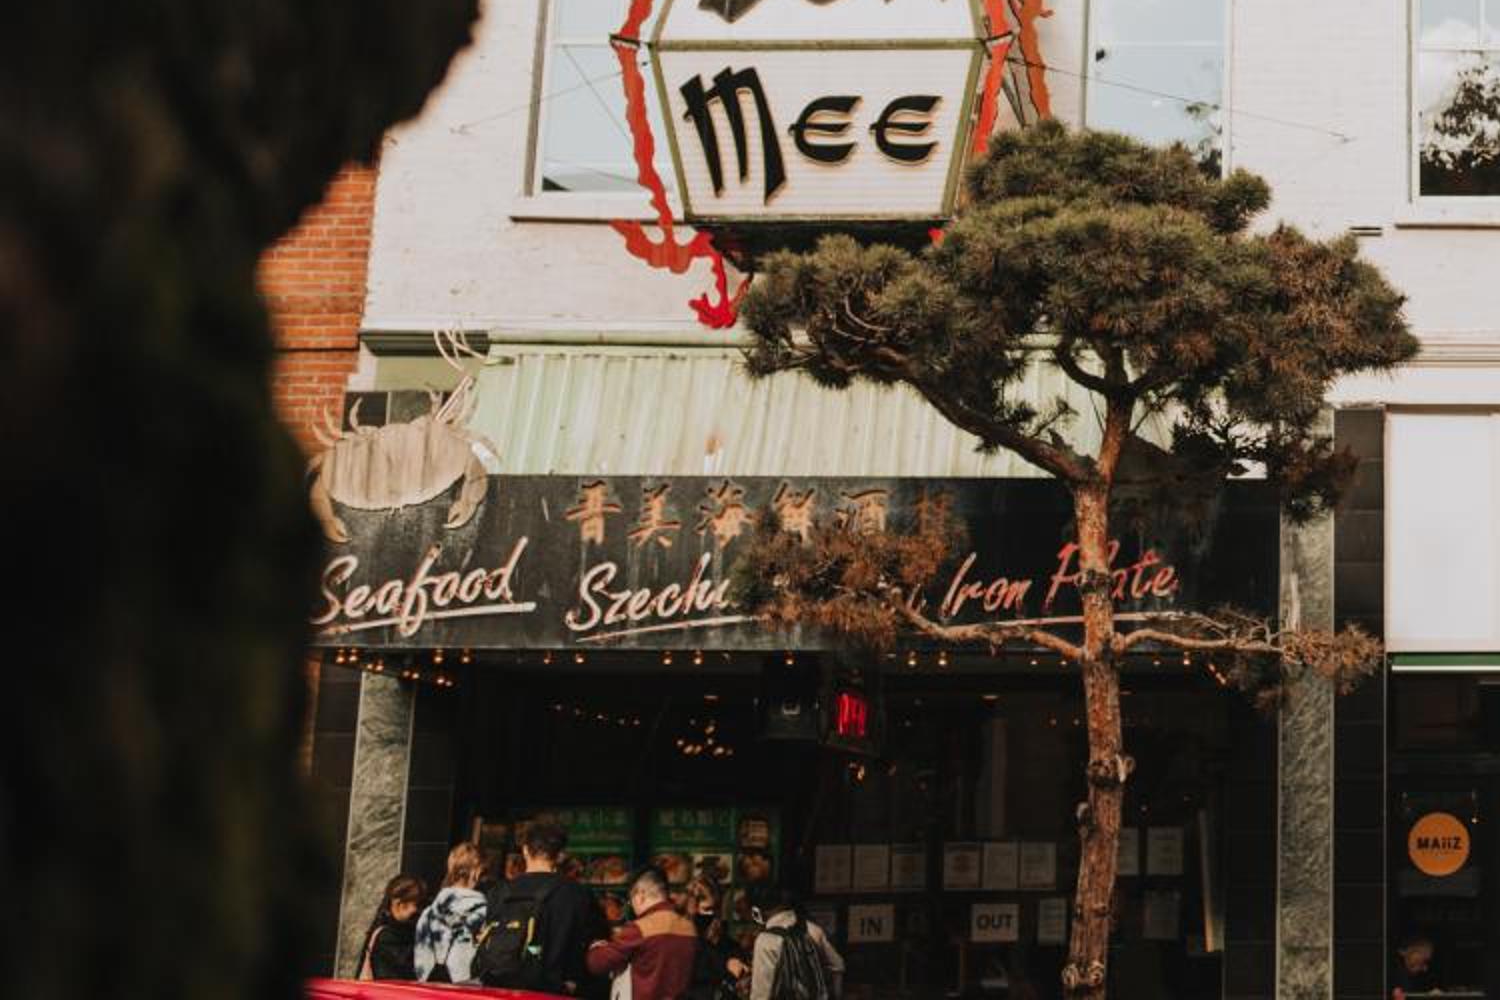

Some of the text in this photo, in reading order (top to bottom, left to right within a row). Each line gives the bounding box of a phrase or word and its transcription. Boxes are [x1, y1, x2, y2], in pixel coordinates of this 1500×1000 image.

[309, 536, 529, 638] Seafood
[939, 552, 1032, 617] Iron
[859, 917, 882, 936] IN
[977, 913, 1013, 931] OUT
